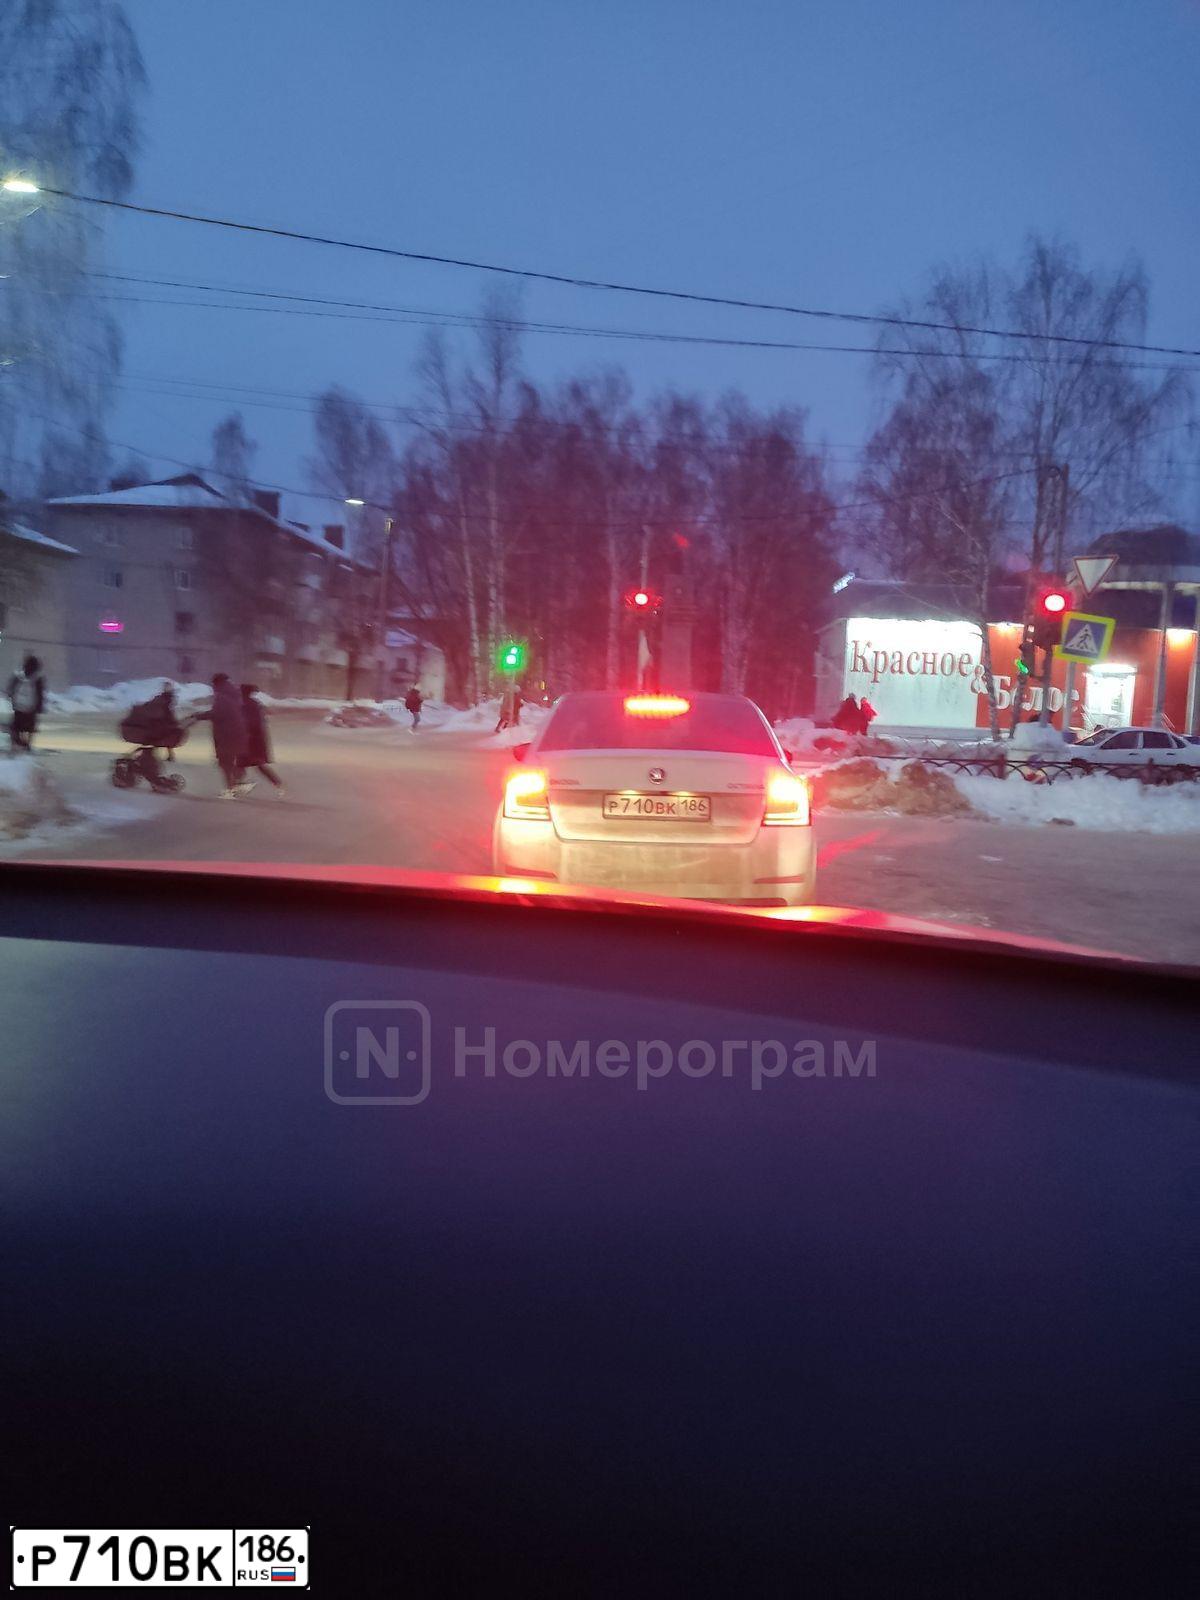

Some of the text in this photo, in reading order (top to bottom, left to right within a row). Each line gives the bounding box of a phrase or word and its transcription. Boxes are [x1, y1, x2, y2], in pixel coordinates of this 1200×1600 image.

[850, 640, 974, 683] Красное
[970, 664, 989, 694] &
[681, 799, 707, 812] 186
